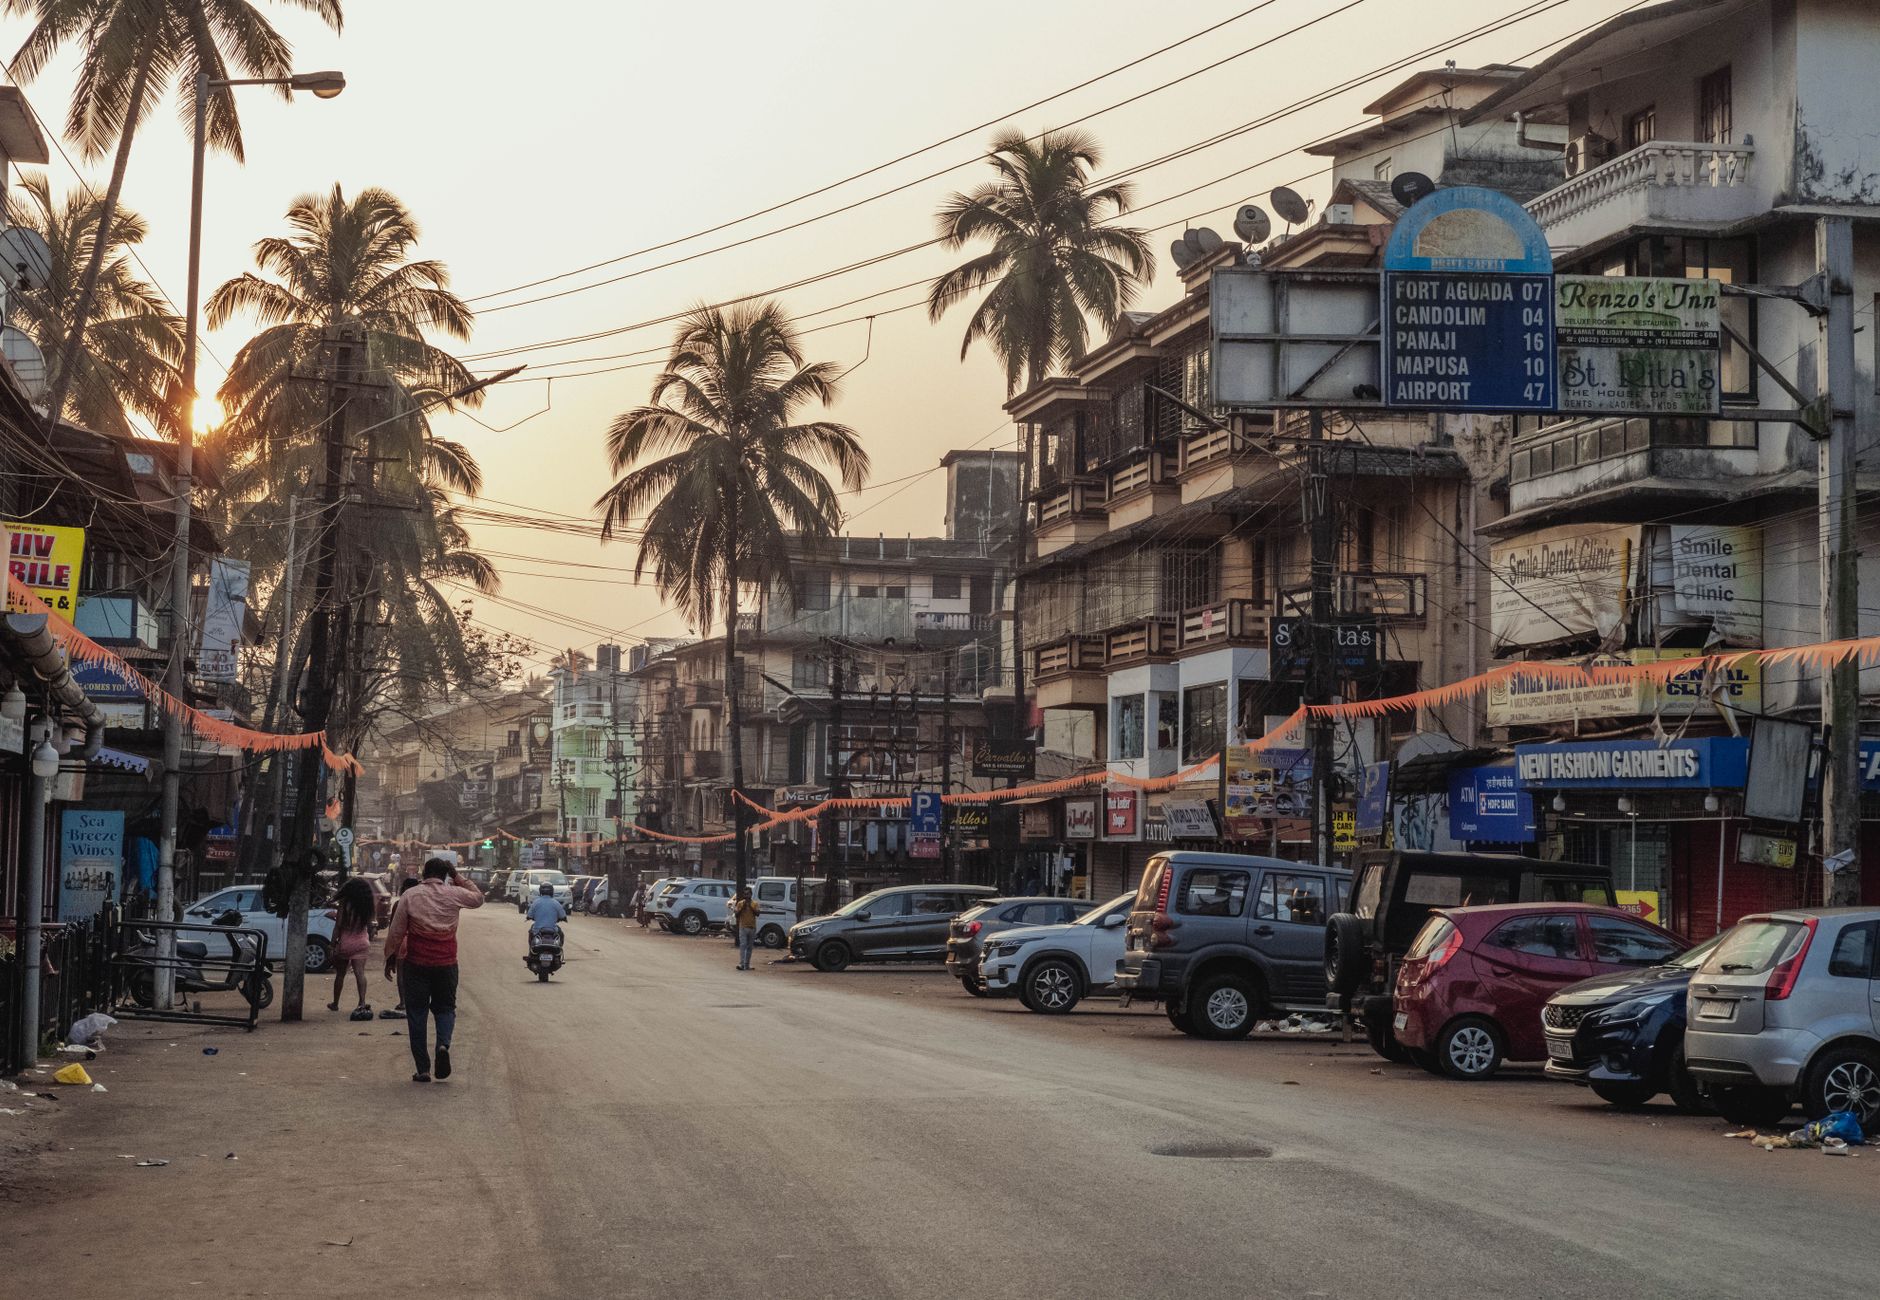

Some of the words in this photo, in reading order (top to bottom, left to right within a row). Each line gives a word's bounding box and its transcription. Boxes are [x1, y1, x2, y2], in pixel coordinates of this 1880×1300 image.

[1395, 281, 1440, 300] FORT
[1445, 282, 1513, 301] AGUADA
[1521, 283, 1543, 301] 07
[1560, 281, 1656, 309] Renzo's
[1664, 283, 1717, 310] Inn
[1396, 306, 1486, 325] CANDOLIM
[1521, 307, 1544, 326] 04
[1633, 320, 1678, 328] RESTAURANT
[1396, 331, 1456, 350] PANAJI
[1523, 332, 1544, 351] 16
[1396, 356, 1469, 376] MAPUSA
[1523, 357, 1544, 377] 10
[1562, 357, 1608, 388] St.
[1617, 358, 1716, 390] Rita's
[1395, 381, 1471, 401] AIRPORT
[1523, 383, 1545, 401] 47
[1597, 390, 1641, 398] HOUSE
[1677, 392, 1713, 400] STYLE
[1564, 400, 1593, 408] GENTS
[1656, 401, 1678, 410] KIDS
[1680, 538, 1733, 556] Smile
[1509, 547, 1537, 586] Smile
[1541, 540, 1578, 577] Dental
[1578, 535, 1616, 572] Clinic
[1677, 561, 1737, 579] Dental
[1681, 585, 1734, 602] Clinic
[1518, 752, 1550, 780] NEW
[1551, 751, 1612, 779] FASHION
[1611, 748, 1699, 778] GARMENTS
[1460, 787, 1475, 803] ATM
[916, 795, 933, 816] P
[1487, 799, 1501, 809] HDFC
[1501, 799, 1516, 810] BANK
[80, 814, 104, 828] Sea
[1171, 809, 1191, 824] WORLD
[1145, 824, 1173, 841] TATTOO
[1336, 822, 1353, 830] CARS
[67, 829, 118, 842] Breeze
[69, 843, 115, 857] Wines
